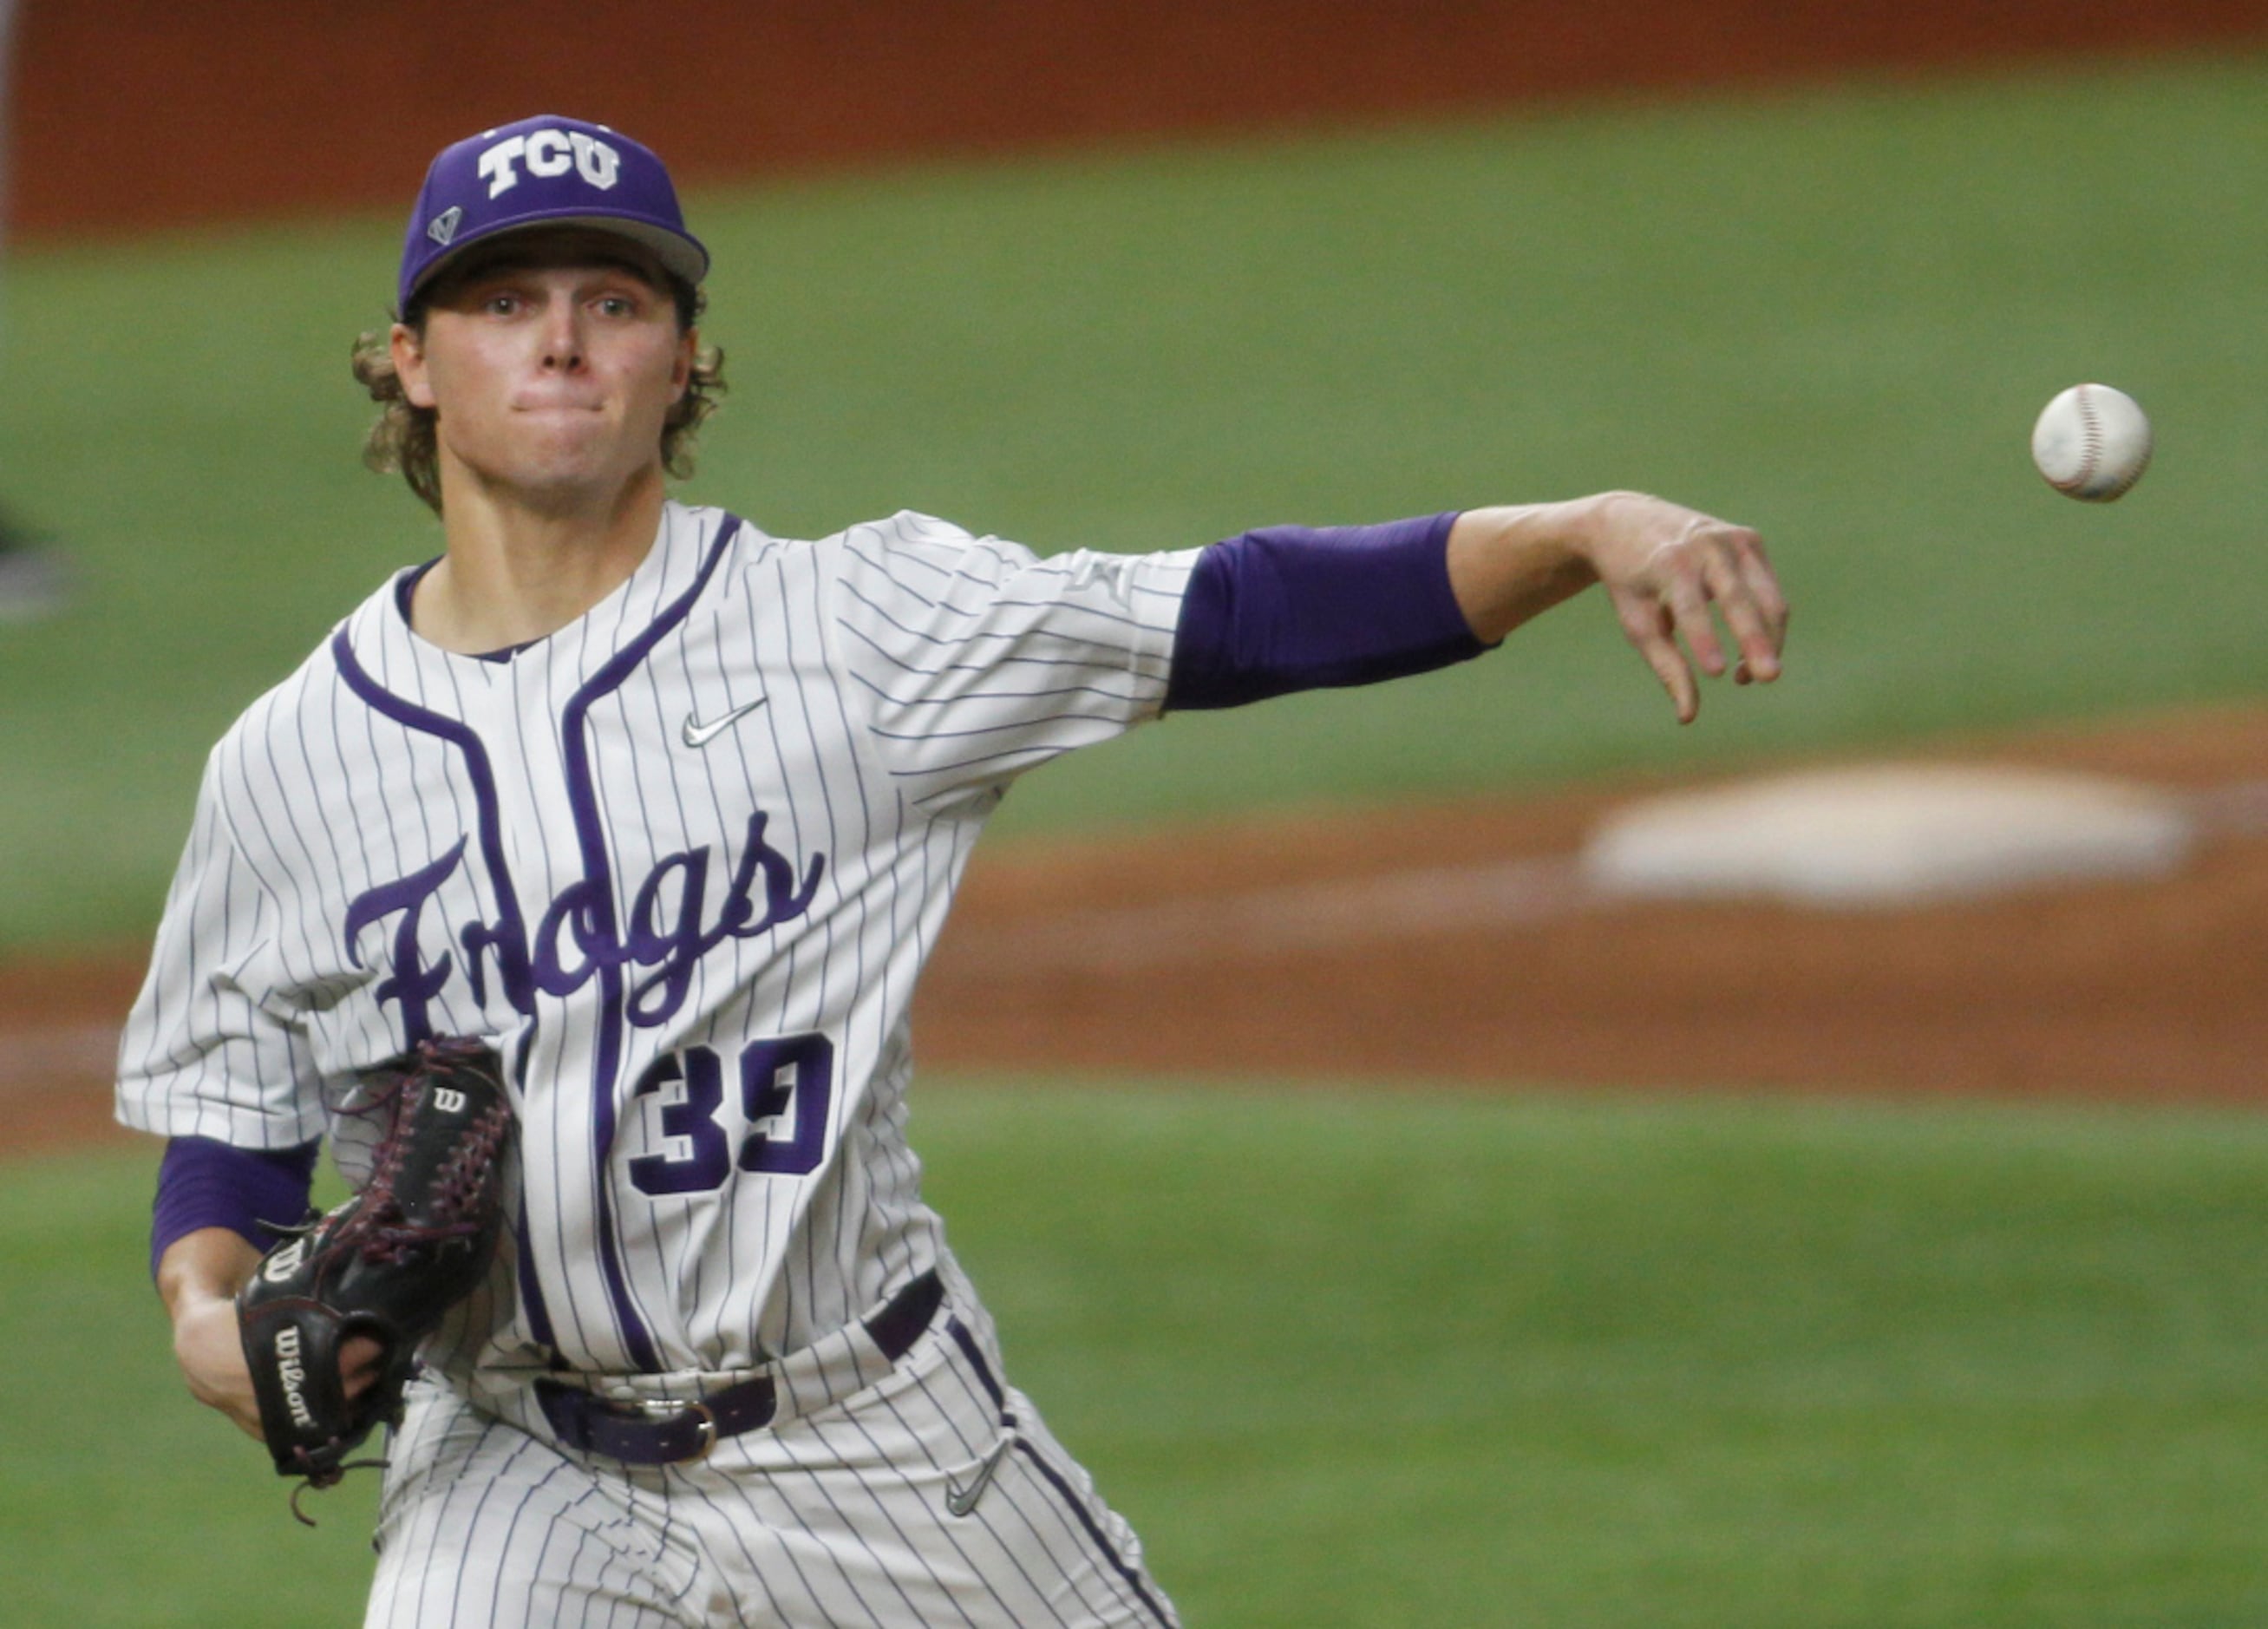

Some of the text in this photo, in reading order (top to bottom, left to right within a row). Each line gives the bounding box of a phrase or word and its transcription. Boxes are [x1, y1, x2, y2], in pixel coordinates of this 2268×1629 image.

[478, 128, 620, 200] TCU
[344, 810, 826, 1052] Frogs
[275, 1325, 313, 1427] Wilson
